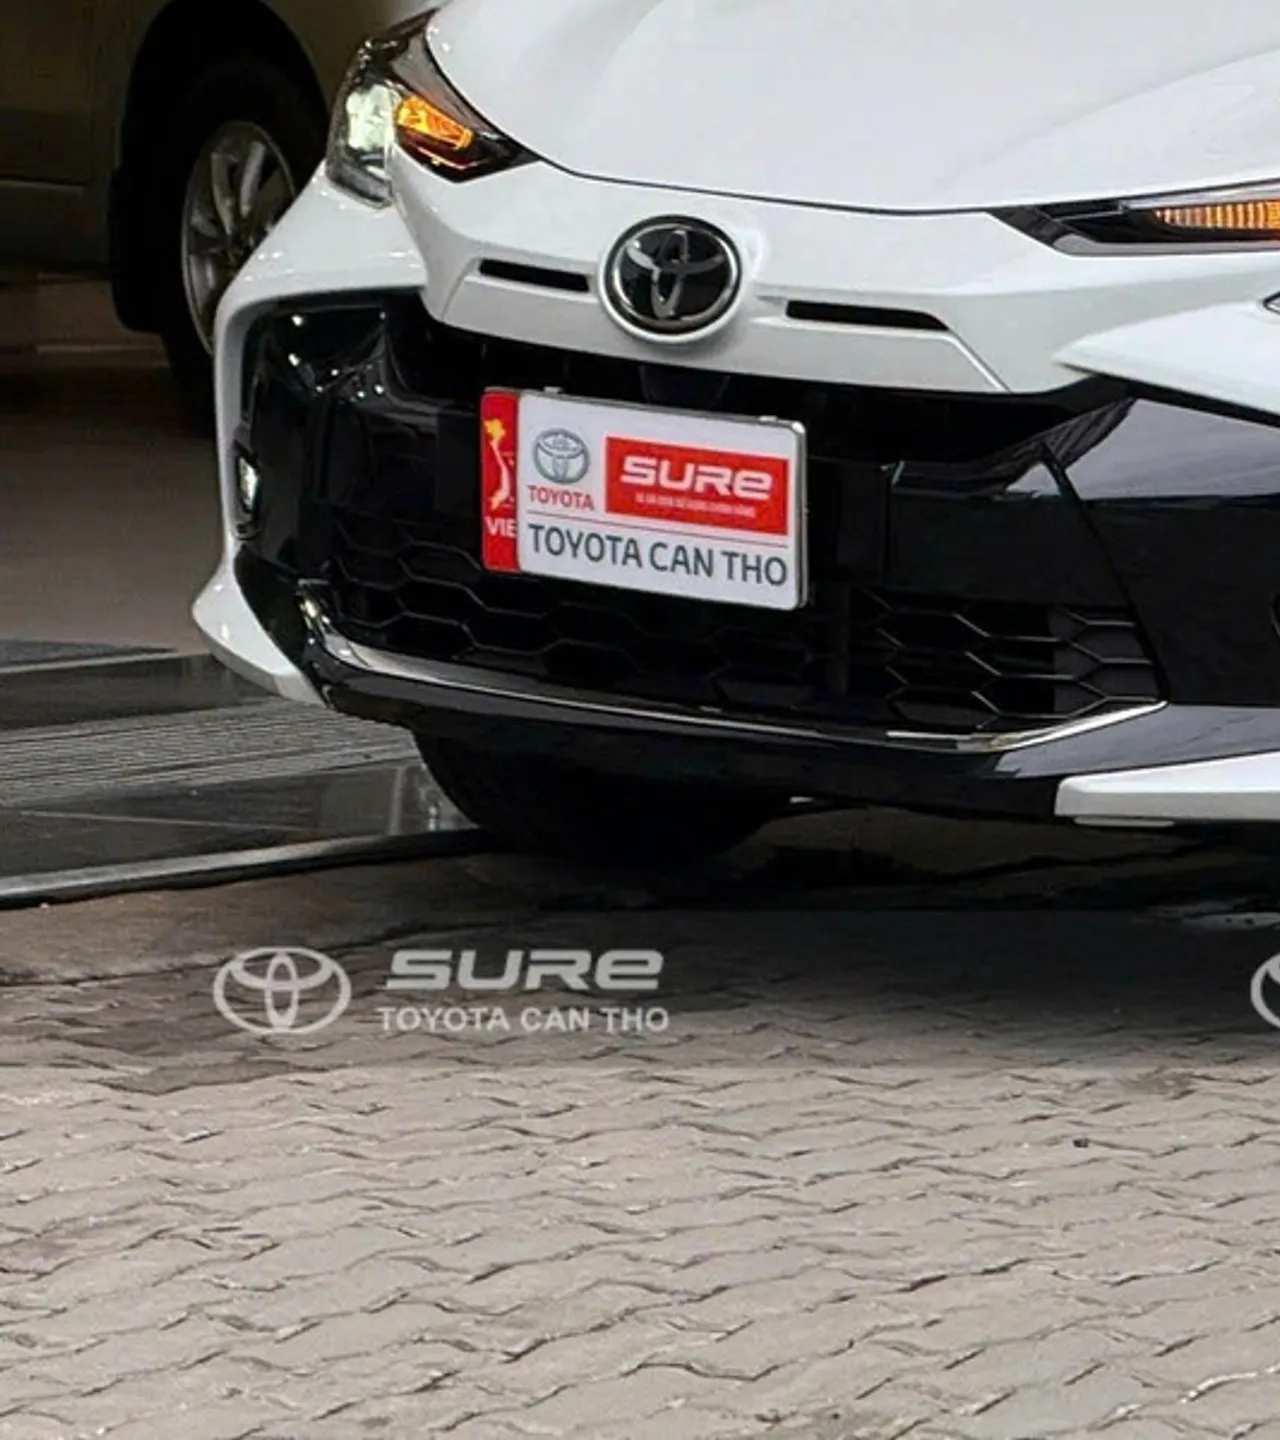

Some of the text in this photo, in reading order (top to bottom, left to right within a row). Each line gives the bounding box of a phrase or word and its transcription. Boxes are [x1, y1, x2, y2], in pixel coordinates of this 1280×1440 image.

[526, 484, 594, 511] TOYOTA
[527, 522, 788, 587] TOYOTA CAN THO
